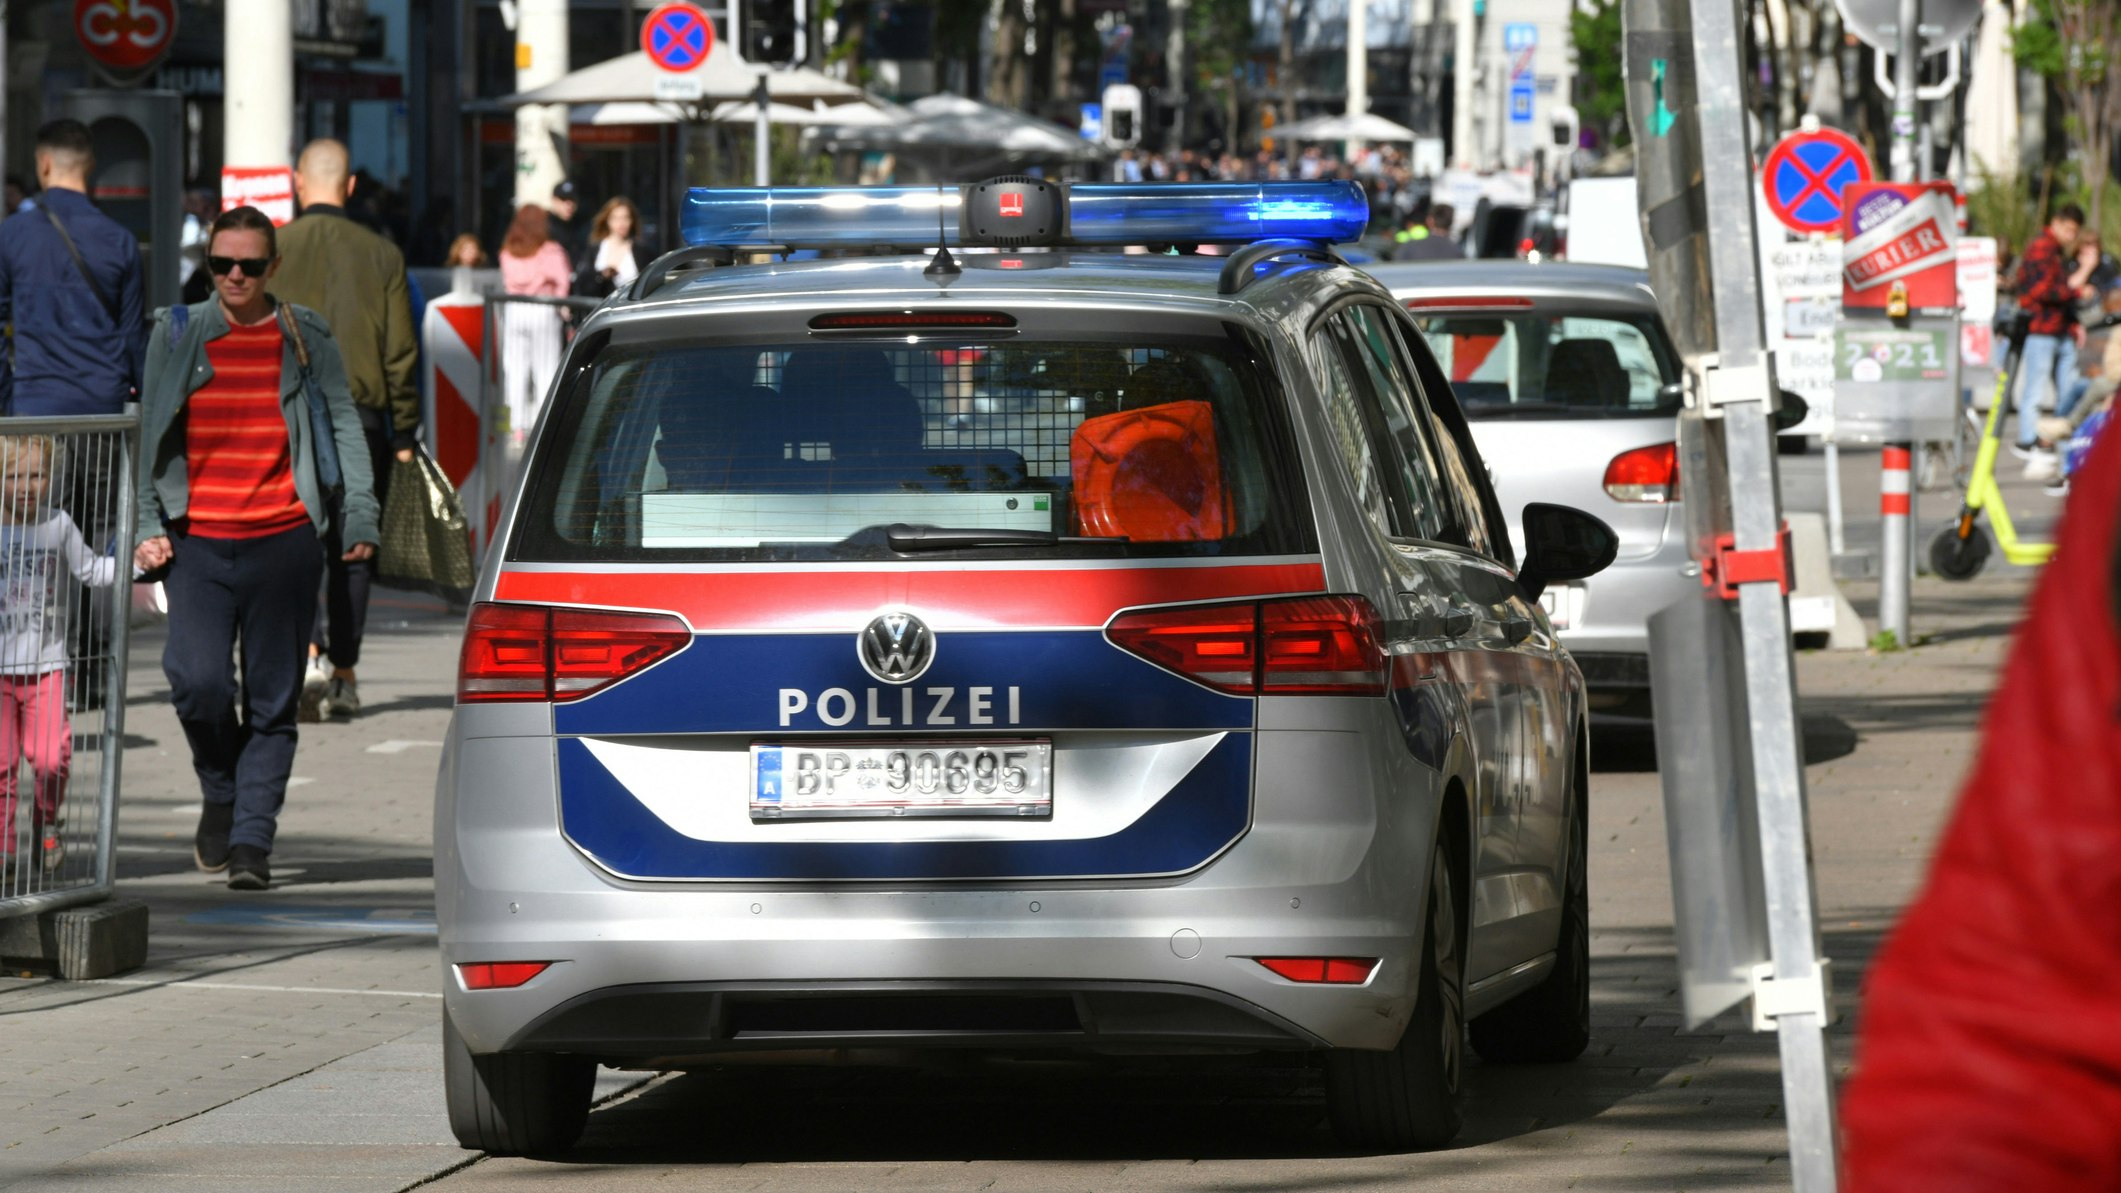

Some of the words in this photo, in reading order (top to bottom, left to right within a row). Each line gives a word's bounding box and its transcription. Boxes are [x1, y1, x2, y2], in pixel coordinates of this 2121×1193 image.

[1850, 228, 1942, 279] KURIER
[779, 686, 1020, 727] POLIZEI
[764, 782, 776, 795] A
[797, 752, 850, 795] BP
[886, 750, 1028, 795] 90695
